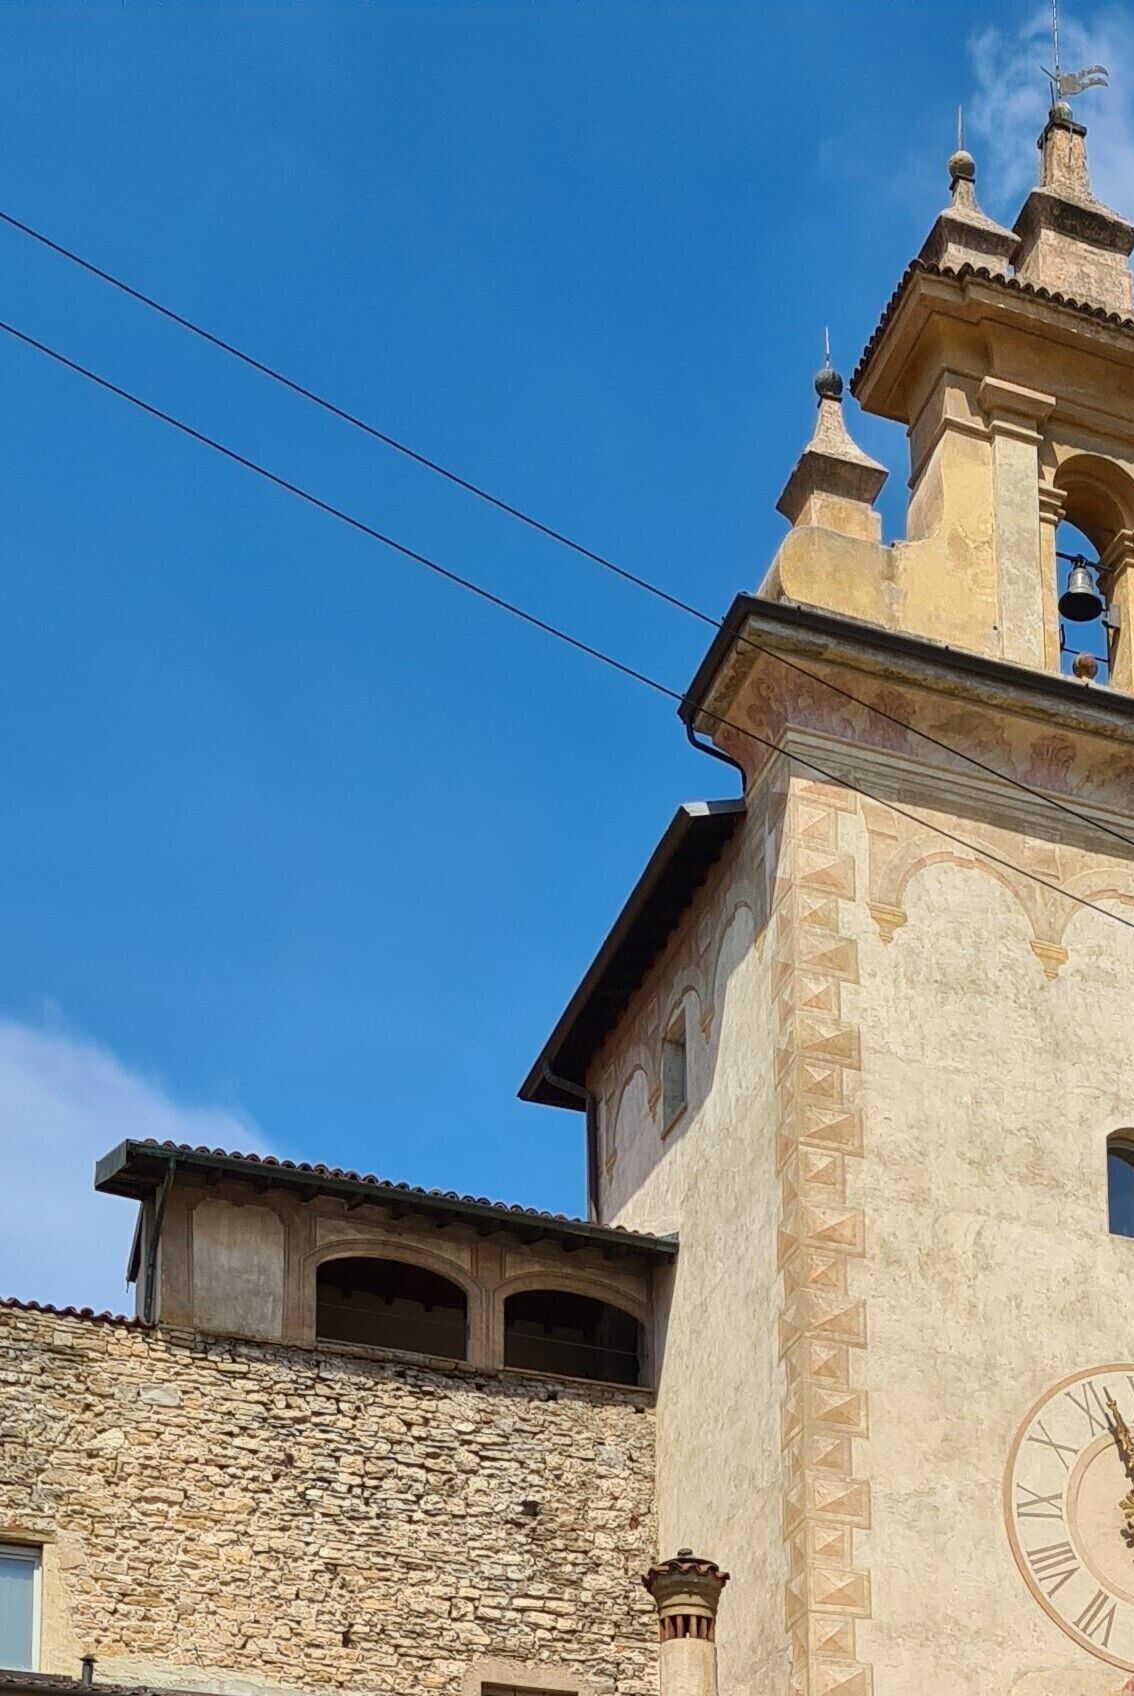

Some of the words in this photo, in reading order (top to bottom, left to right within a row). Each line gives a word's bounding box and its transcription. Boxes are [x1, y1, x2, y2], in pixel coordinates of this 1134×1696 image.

[1065, 1381, 1113, 1438] XI
[1027, 1419, 1079, 1472] X
[1016, 1482, 1064, 1520] IX
[1026, 1540, 1081, 1598] VIII
[1072, 1588, 1118, 1648] VII
